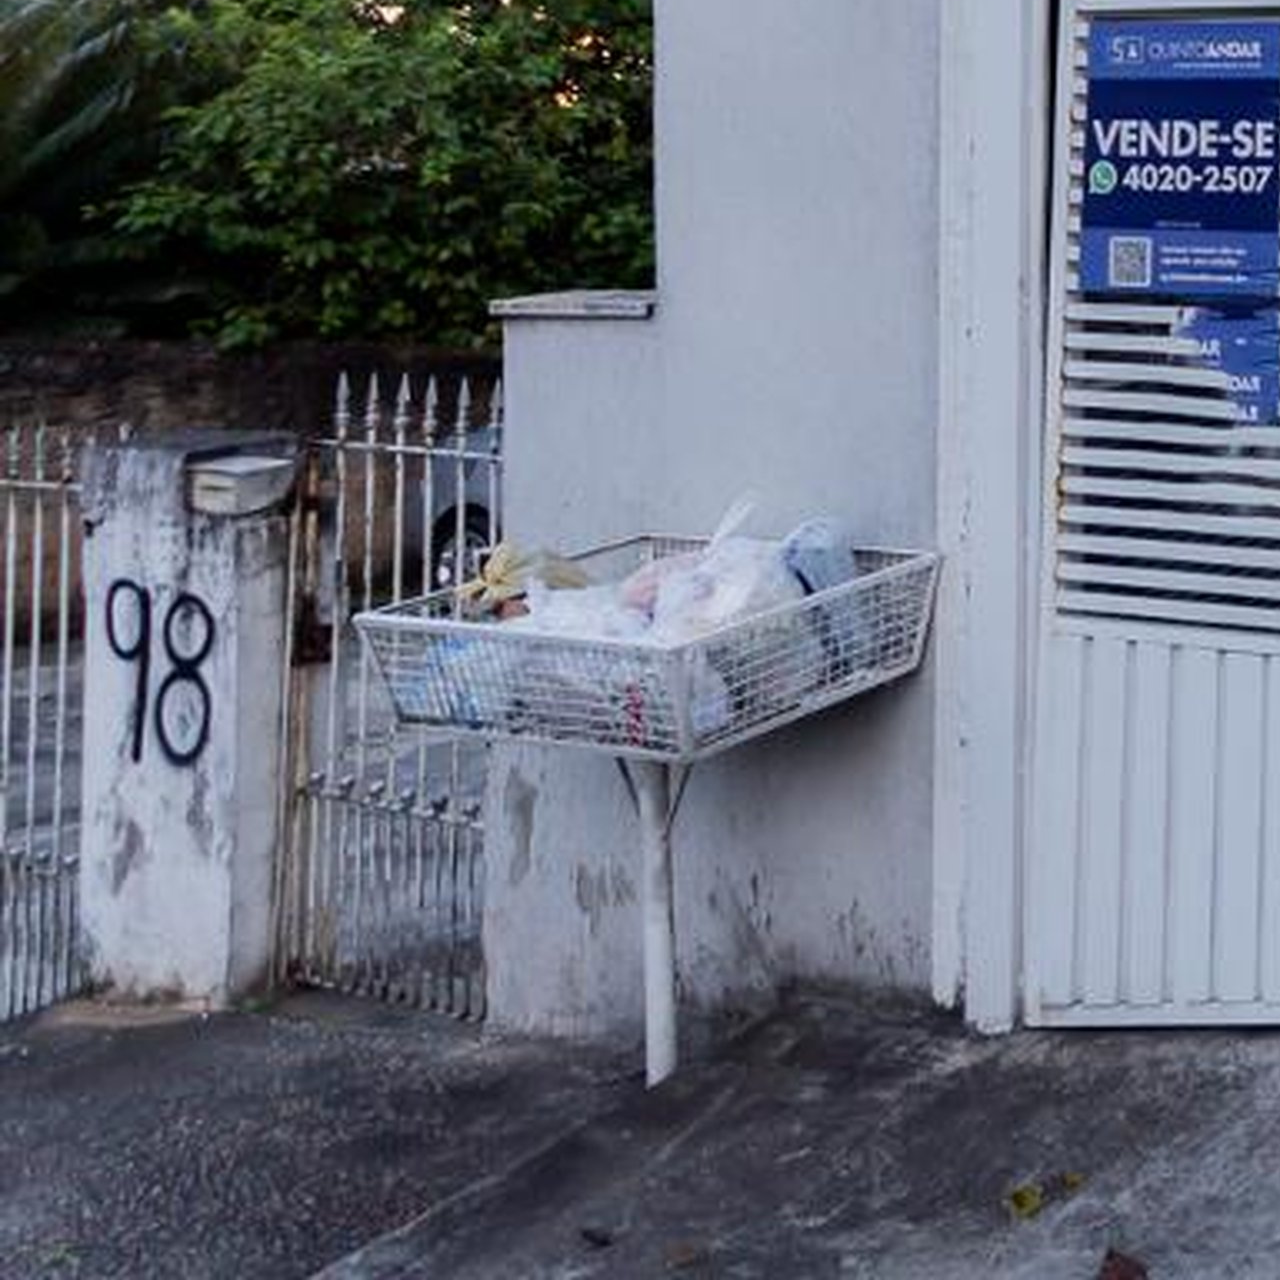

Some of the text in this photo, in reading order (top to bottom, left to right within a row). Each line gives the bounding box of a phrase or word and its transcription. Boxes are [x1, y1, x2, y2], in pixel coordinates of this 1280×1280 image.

[1093, 119, 1275, 158] VENDE-SE
[1122, 165, 1274, 192] 4020-2507
[106, 578, 216, 766] 98
